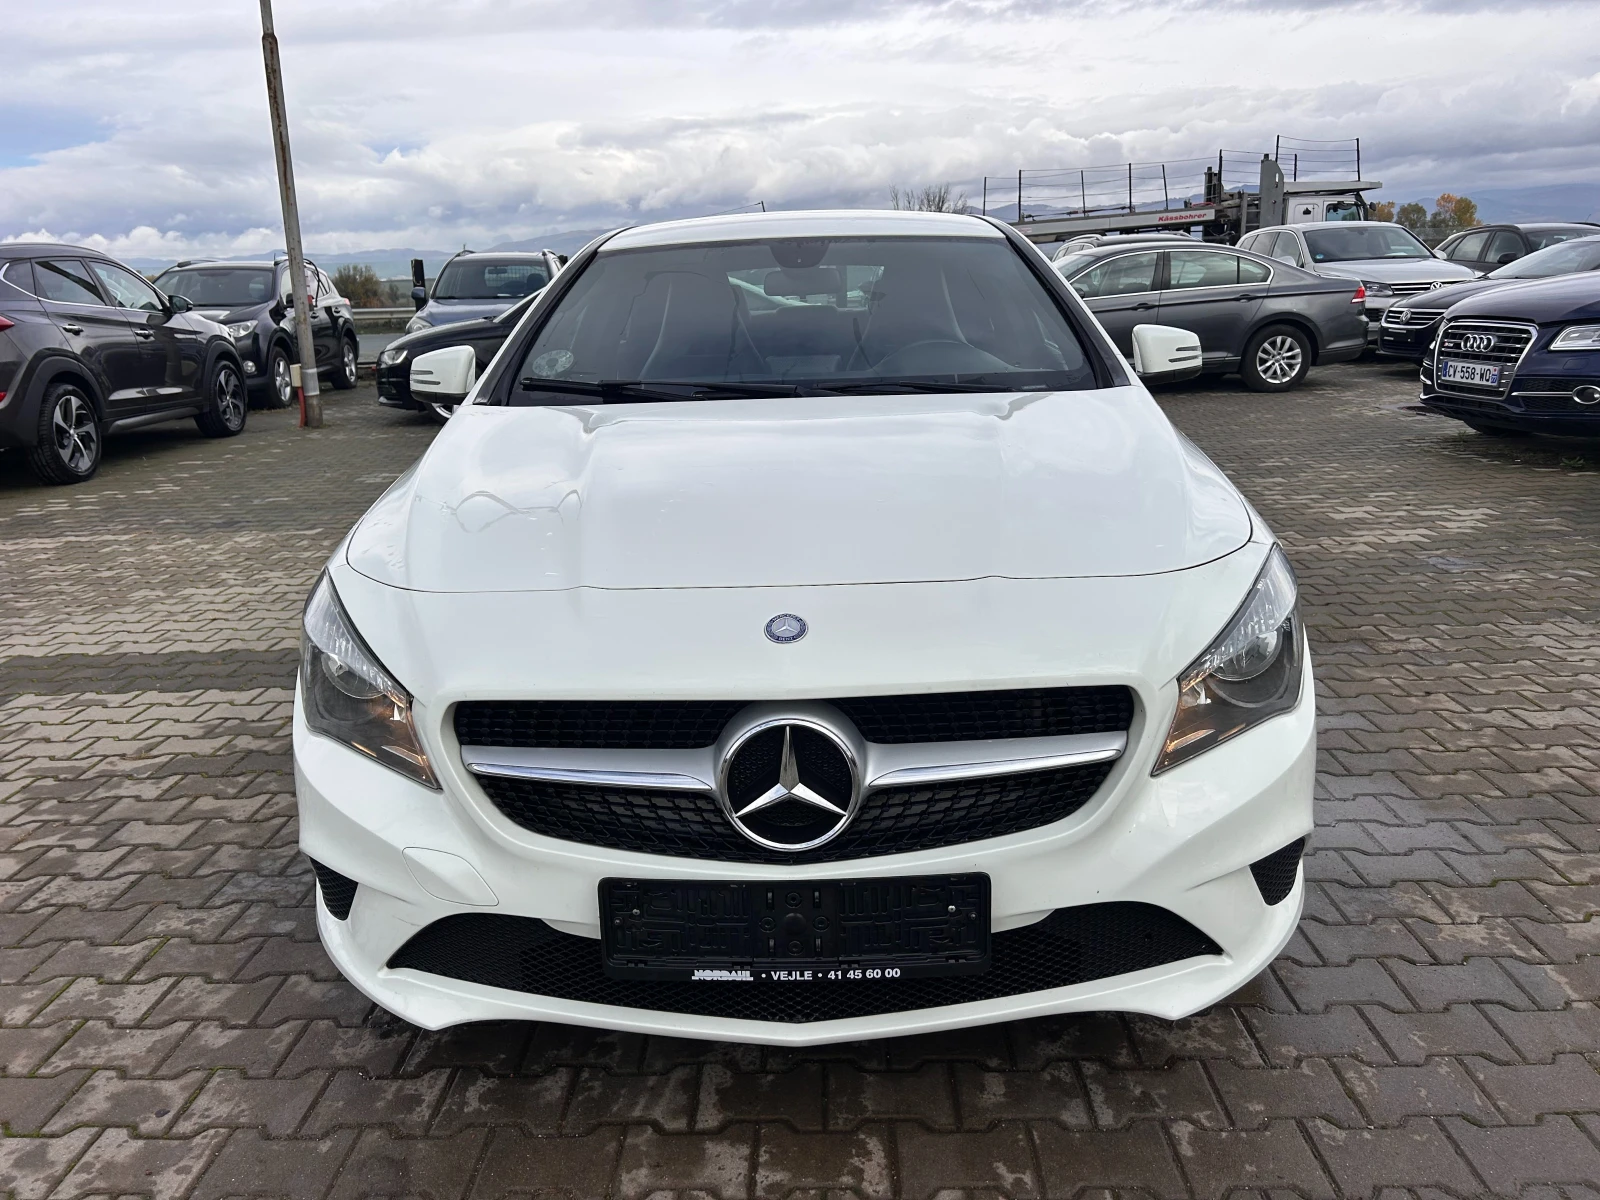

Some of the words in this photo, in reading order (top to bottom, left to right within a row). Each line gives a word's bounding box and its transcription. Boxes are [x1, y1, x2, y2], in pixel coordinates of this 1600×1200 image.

[1157, 213, 1207, 222] Kässbohrer
[770, 970, 813, 981] VEJLE
[827, 970, 842, 980] 41
[846, 969, 862, 980] 45
[865, 968, 882, 979] 60
[884, 967, 901, 978] 00
